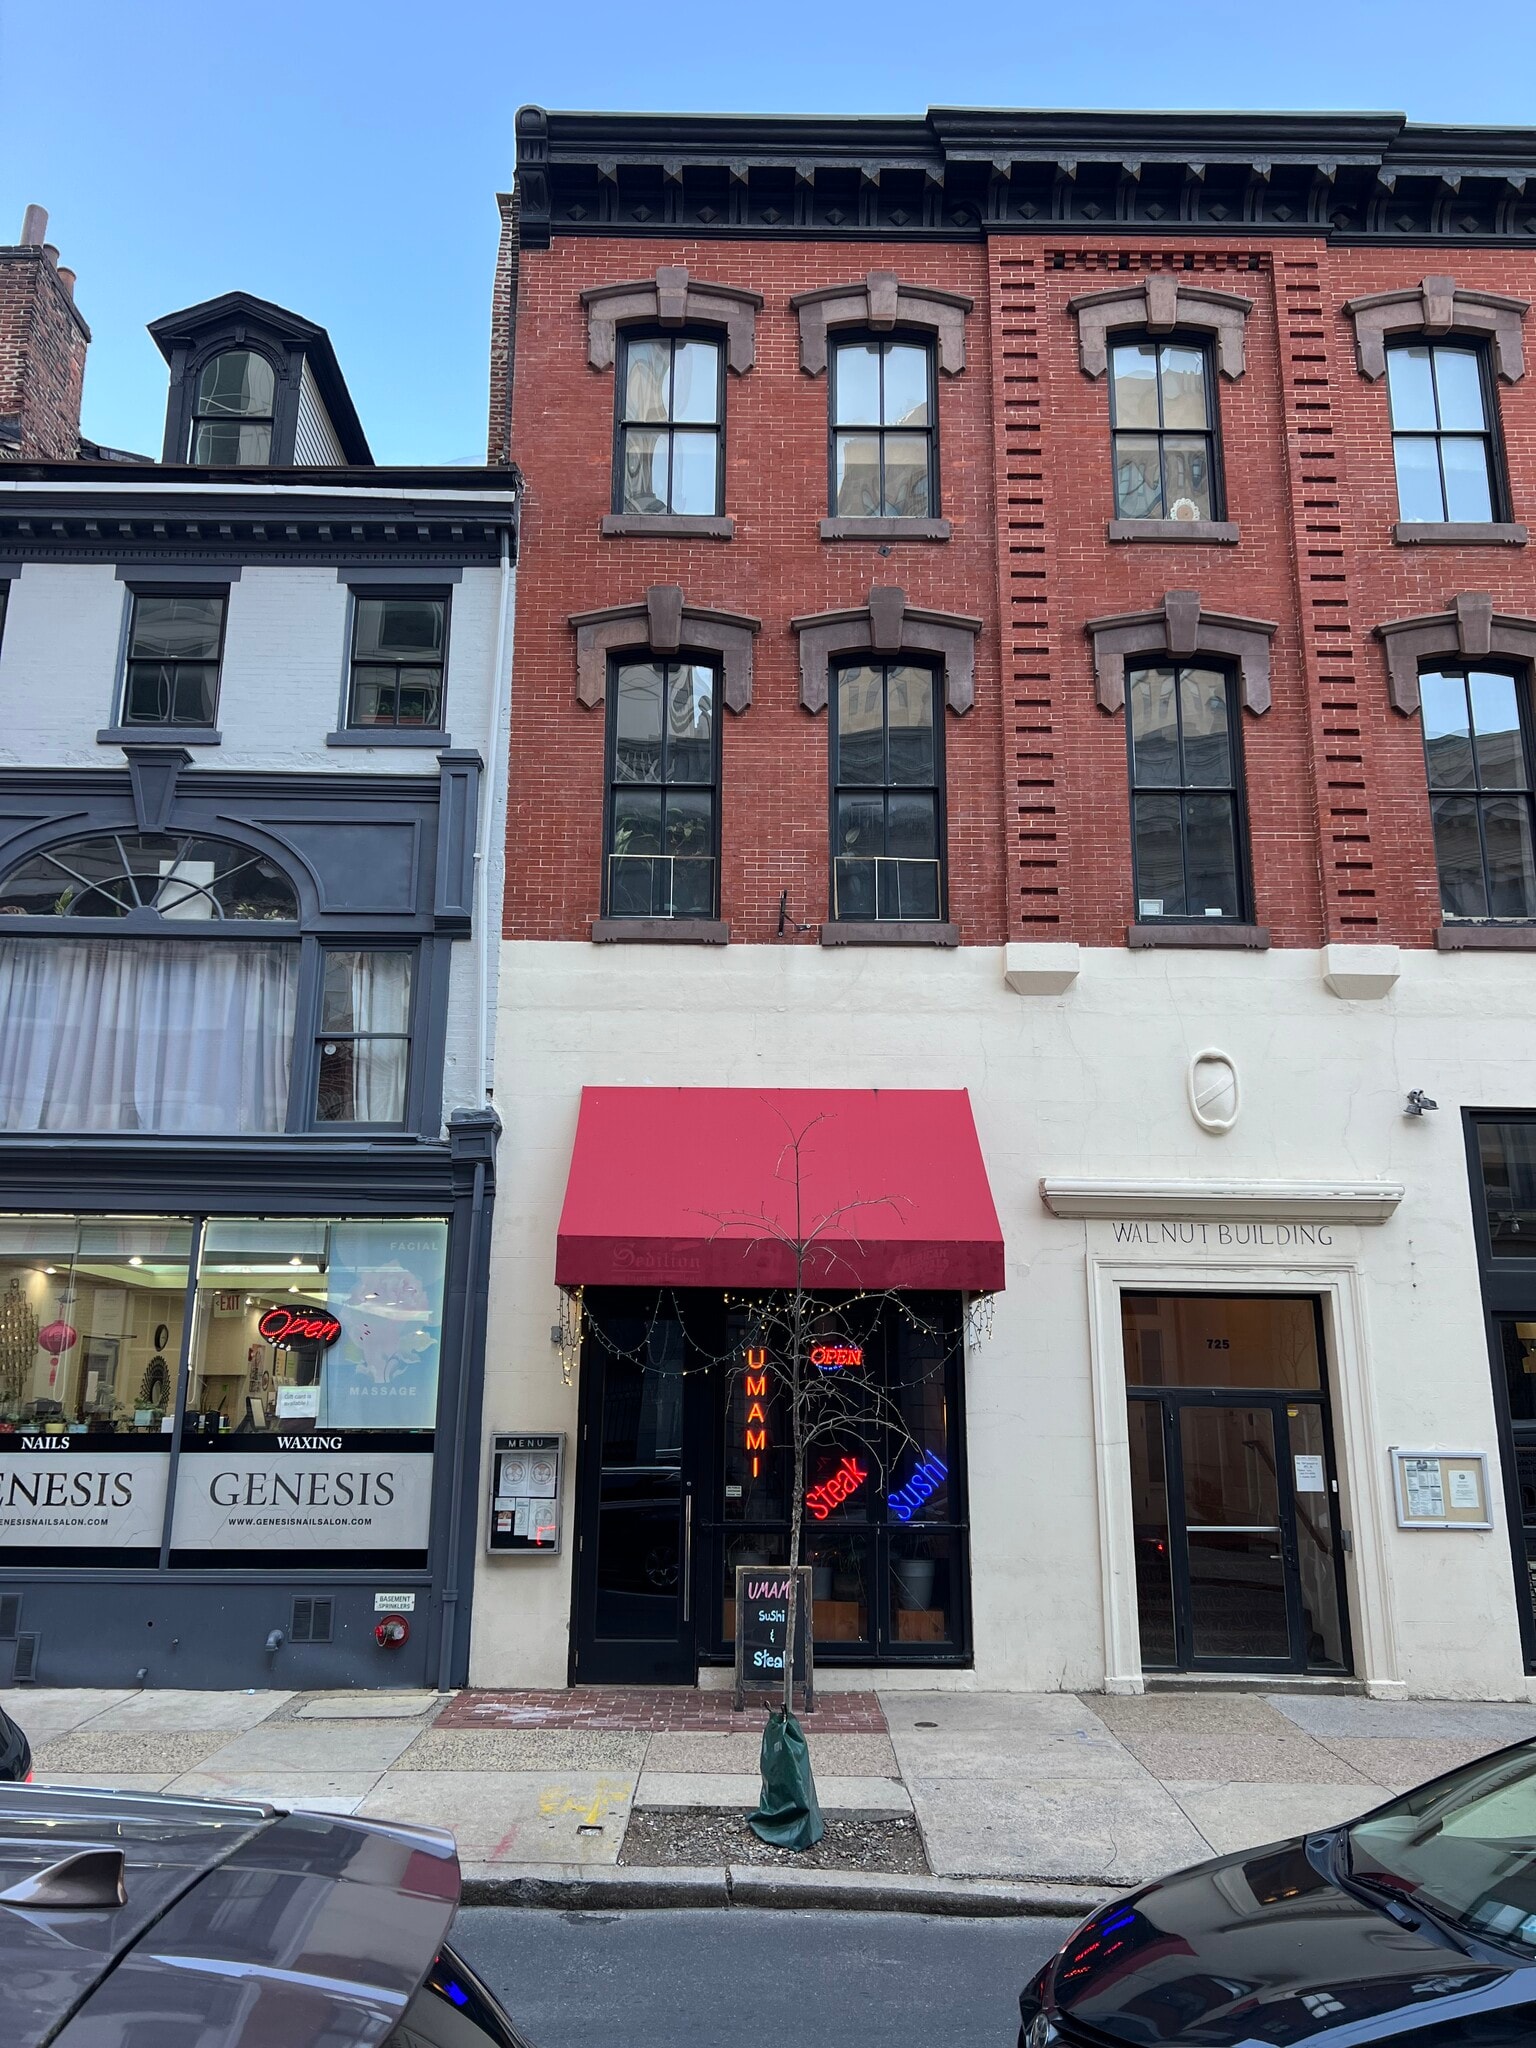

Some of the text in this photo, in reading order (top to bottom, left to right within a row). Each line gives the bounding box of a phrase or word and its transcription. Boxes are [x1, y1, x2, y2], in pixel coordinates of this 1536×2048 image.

[1112, 1222, 1333, 1246] WALNUT BUILDING
[390, 1242, 439, 1251] FACIAL
[220, 1294, 241, 1311] EXIT
[260, 1309, 340, 1341] Open
[1206, 1338, 1230, 1350] 725
[810, 1347, 863, 1366] OPEN
[349, 1386, 417, 1396] MASSAGE
[746, 1349, 766, 1478] UMAMI
[21, 1436, 70, 1450] NAILS
[277, 1436, 343, 1450] WAXING
[508, 1439, 543, 1448] MENU
[0, 1472, 133, 1507] NESIS
[209, 1472, 395, 1507] GENESIS
[806, 1457, 868, 1520] Steak
[887, 1449, 949, 1521] Sushi
[228, 1518, 372, 1526] WWW.GENESISNAILSALON.COM
[748, 1581, 799, 1599] UMAM
